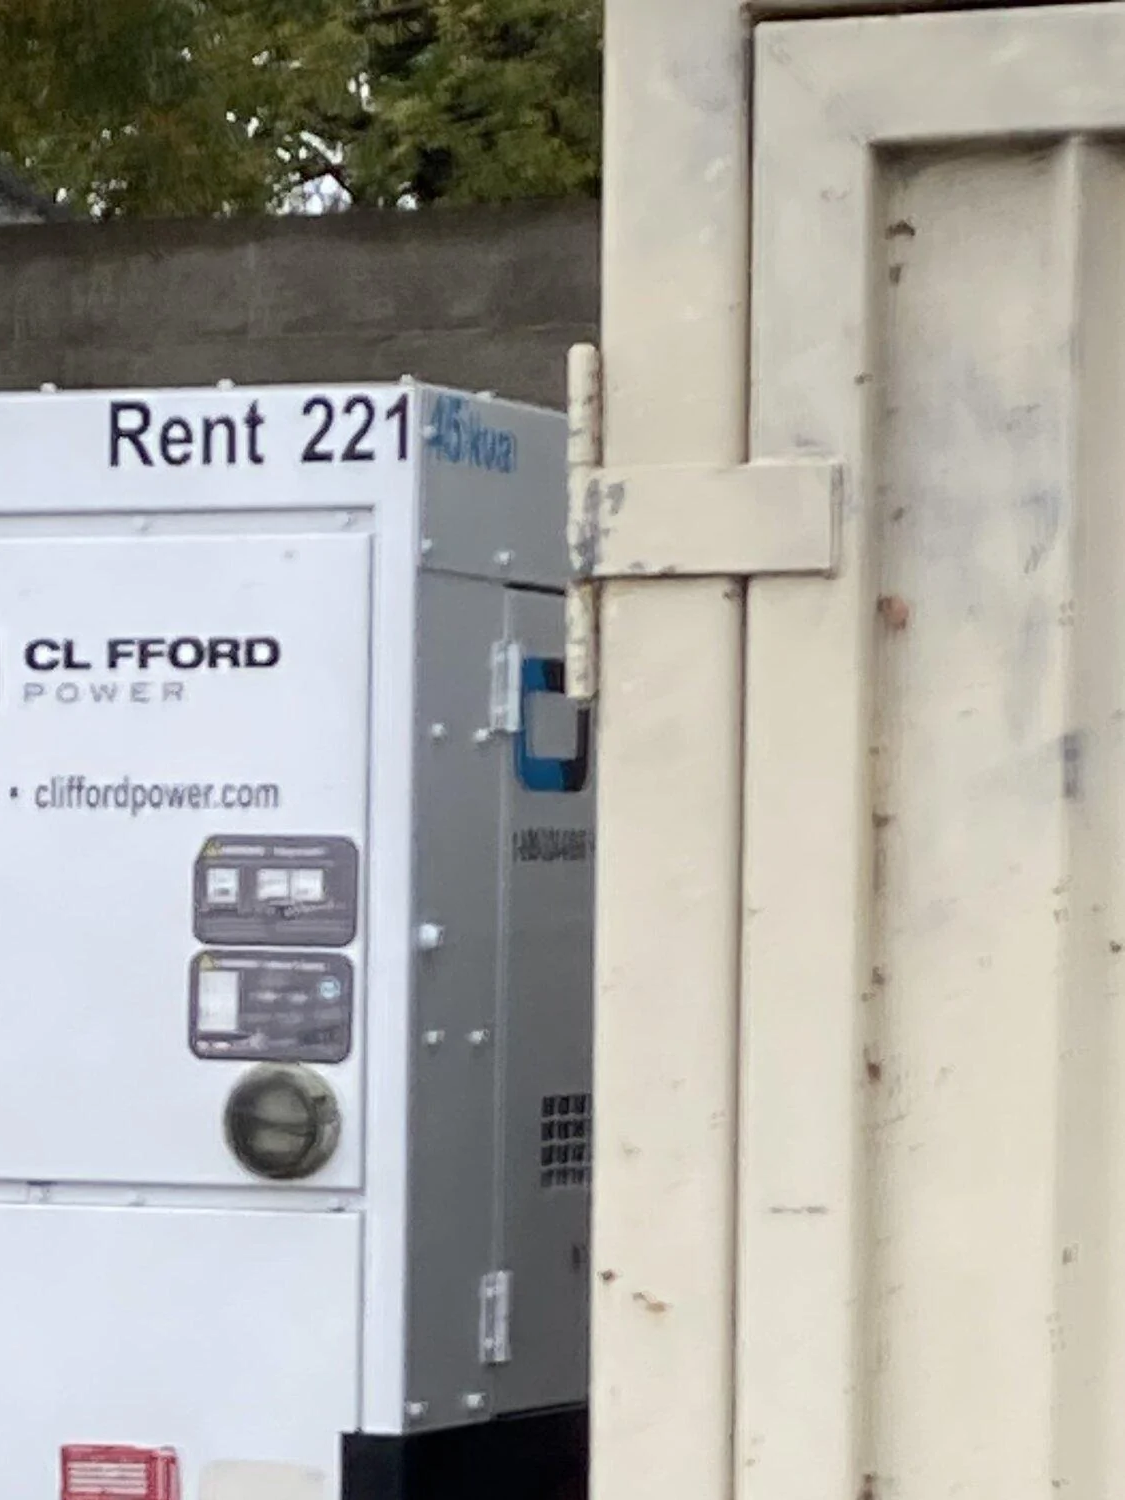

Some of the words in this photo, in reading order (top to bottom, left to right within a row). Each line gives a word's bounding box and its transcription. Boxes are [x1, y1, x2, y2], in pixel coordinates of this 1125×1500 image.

[109, 399, 265, 467] Rent
[301, 392, 410, 464] 221
[23, 681, 185, 703] POWER
[34, 775, 280, 816] cliffordpower.com
